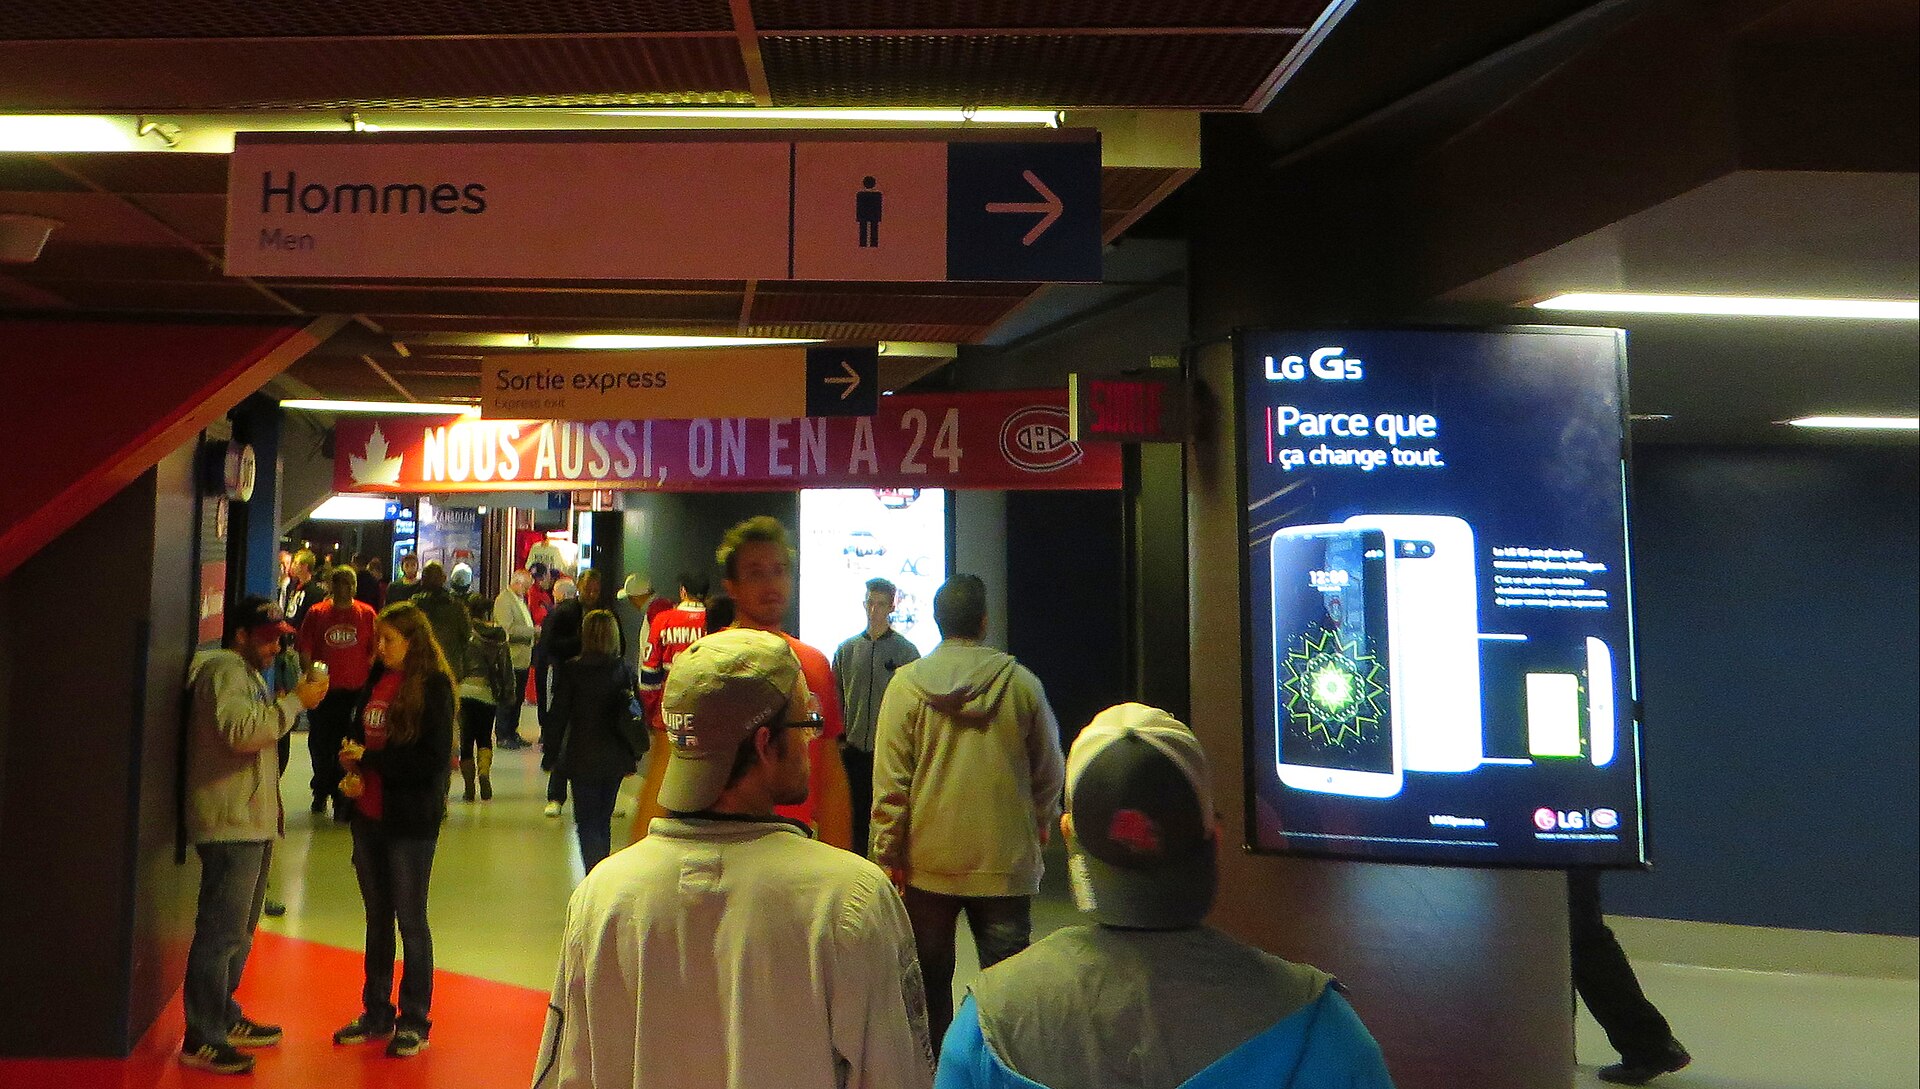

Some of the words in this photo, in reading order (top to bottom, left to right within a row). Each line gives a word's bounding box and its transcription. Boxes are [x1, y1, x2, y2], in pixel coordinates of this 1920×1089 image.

[262, 170, 488, 214] Hommes
[260, 229, 315, 250] Men
[1265, 356, 1305, 380] LG
[1309, 347, 1363, 380] G5
[496, 369, 565, 390] Sortie
[572, 371, 667, 394] express
[1277, 406, 1369, 436] Parce
[1375, 413, 1438, 445] que
[423, 420, 520, 481] NOUS
[534, 419, 668, 487] AUSSI,
[688, 417, 746, 477] ON
[769, 417, 827, 476] EN
[848, 416, 879, 475] A
[900, 407, 964, 473] 24
[1279, 449, 1306, 470] ça
[1309, 444, 1387, 471] change
[1391, 447, 1445, 467] tout.
[1557, 811, 1584, 830] LG
